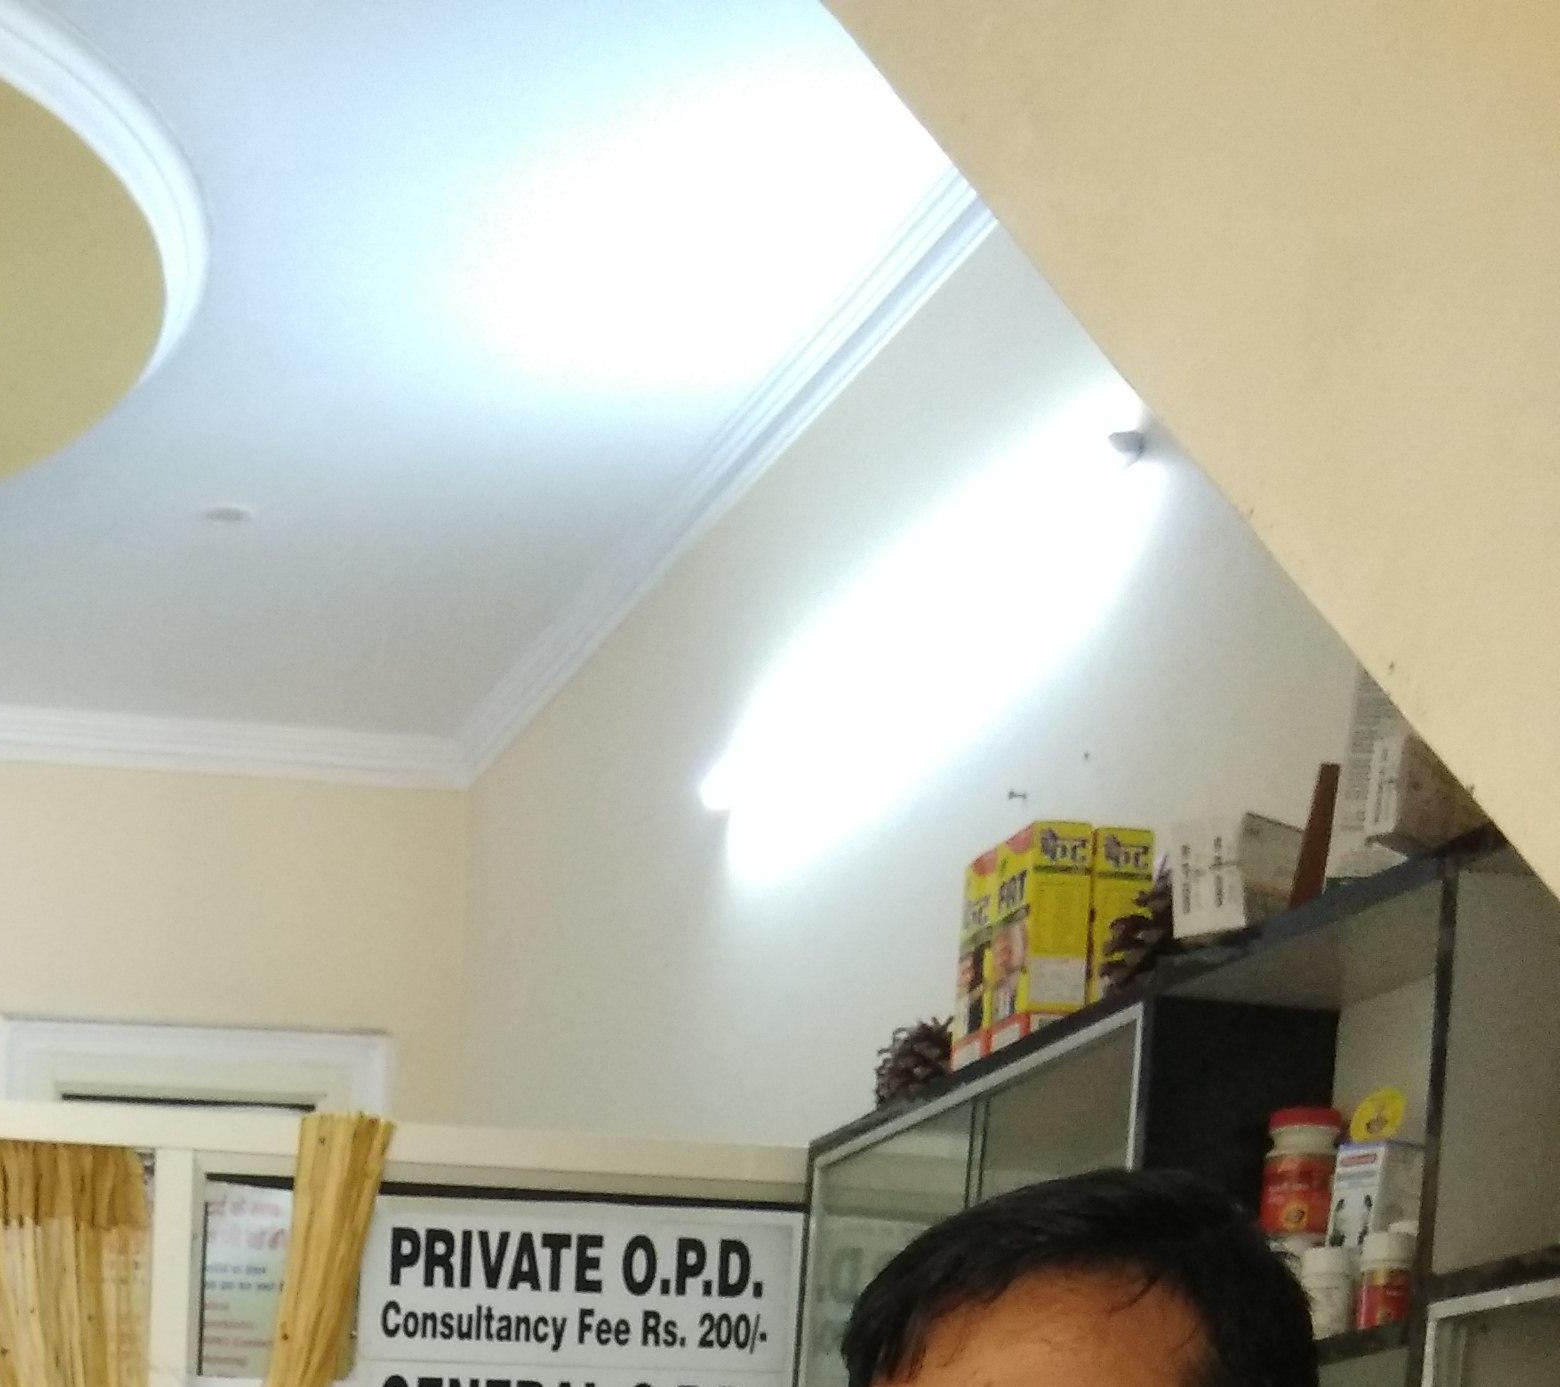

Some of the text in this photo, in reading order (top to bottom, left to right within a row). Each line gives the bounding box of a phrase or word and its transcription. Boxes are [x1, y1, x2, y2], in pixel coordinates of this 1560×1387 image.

[389, 1226, 605, 1294] PRIVATE
[622, 1234, 764, 1299] O.P.D.
[381, 1300, 767, 1354] Consultancy Fee Rs. 200/-
